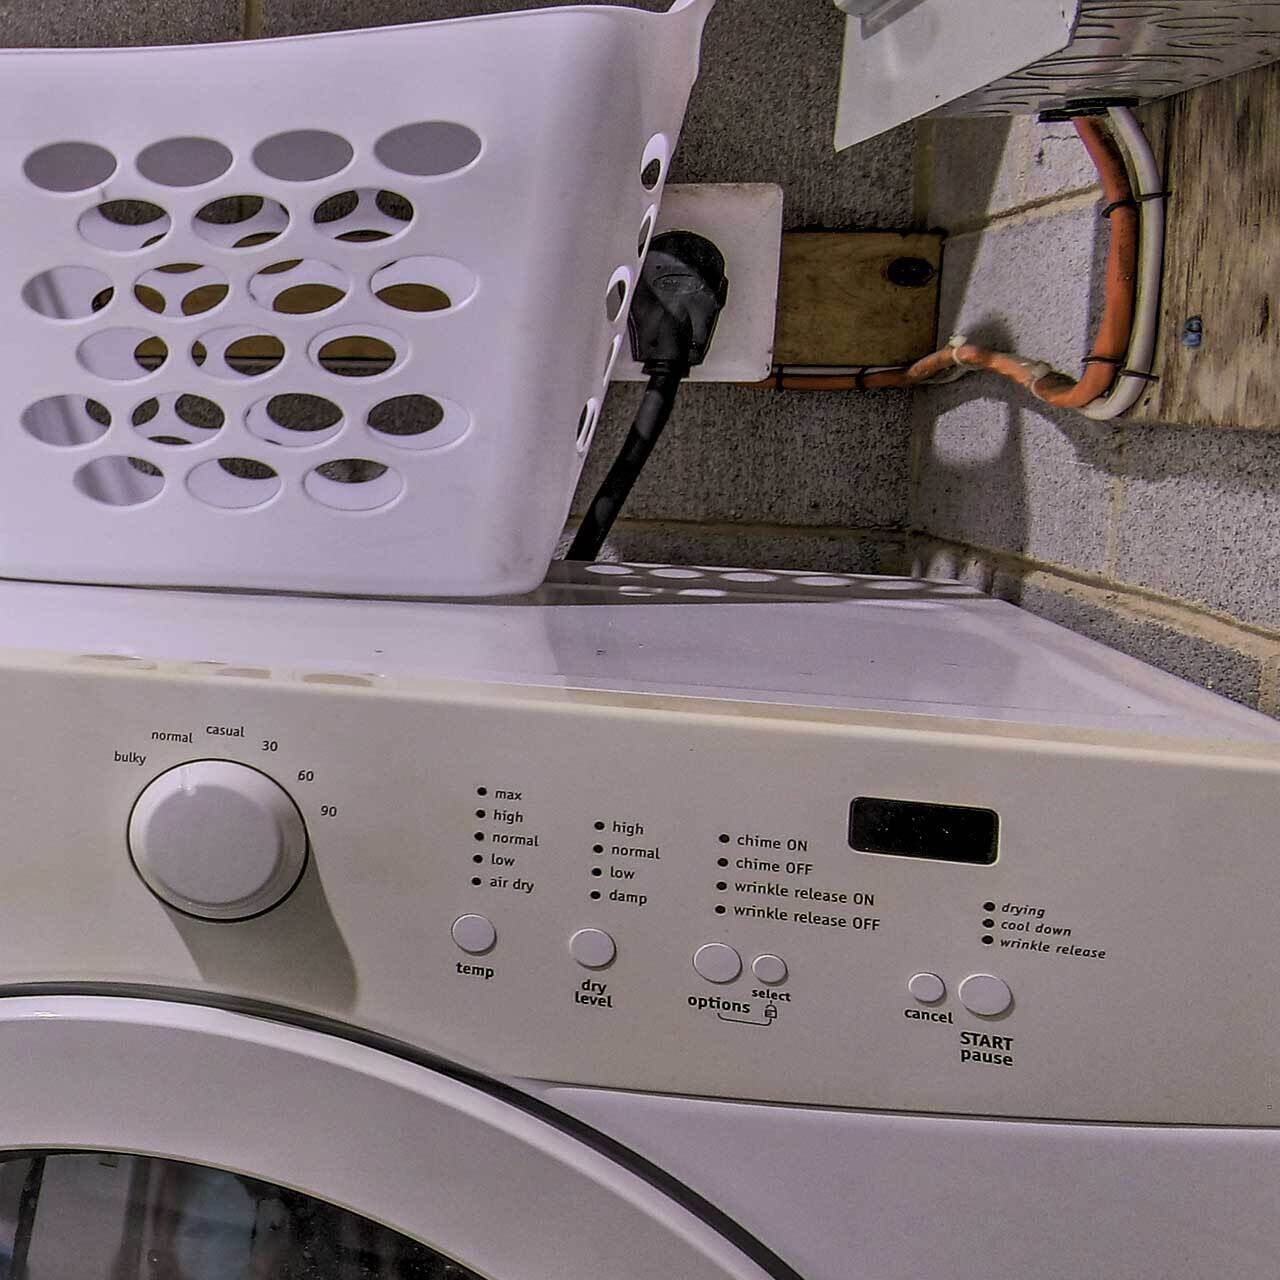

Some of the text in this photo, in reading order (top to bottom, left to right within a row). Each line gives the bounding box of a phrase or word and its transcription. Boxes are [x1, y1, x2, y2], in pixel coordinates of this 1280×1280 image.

[151, 730, 193, 744] normal
[206, 725, 245, 738] casual
[262, 740, 278, 752] 30
[114, 751, 147, 766] bulky
[297, 770, 314, 782] 60
[495, 790, 522, 800] max
[320, 804, 338, 817] 90
[493, 809, 524, 825] high
[612, 821, 644, 837] high
[492, 833, 539, 847] normal
[737, 834, 808, 852] chime ON
[491, 854, 515, 867] low
[611, 845, 660, 860] normal
[610, 866, 635, 880] low
[736, 857, 813, 875] chime OFF
[490, 876, 534, 894] air dry
[609, 890, 648, 906] damp
[735, 881, 874, 906] wrinkle release ON
[734, 905, 881, 931] wrinkle release OFF
[1002, 902, 1045, 919] drying
[1001, 920, 1072, 937] cool down
[1000, 939, 1106, 959] wrinkle release
[456, 962, 495, 980] temp
[581, 979, 607, 996] dry
[752, 988, 791, 1002] select
[575, 991, 612, 1008] level
[688, 995, 750, 1014] options
[904, 1008, 954, 1025] cancel
[960, 1032, 1013, 1051] START
[960, 1050, 1013, 1066] pause
